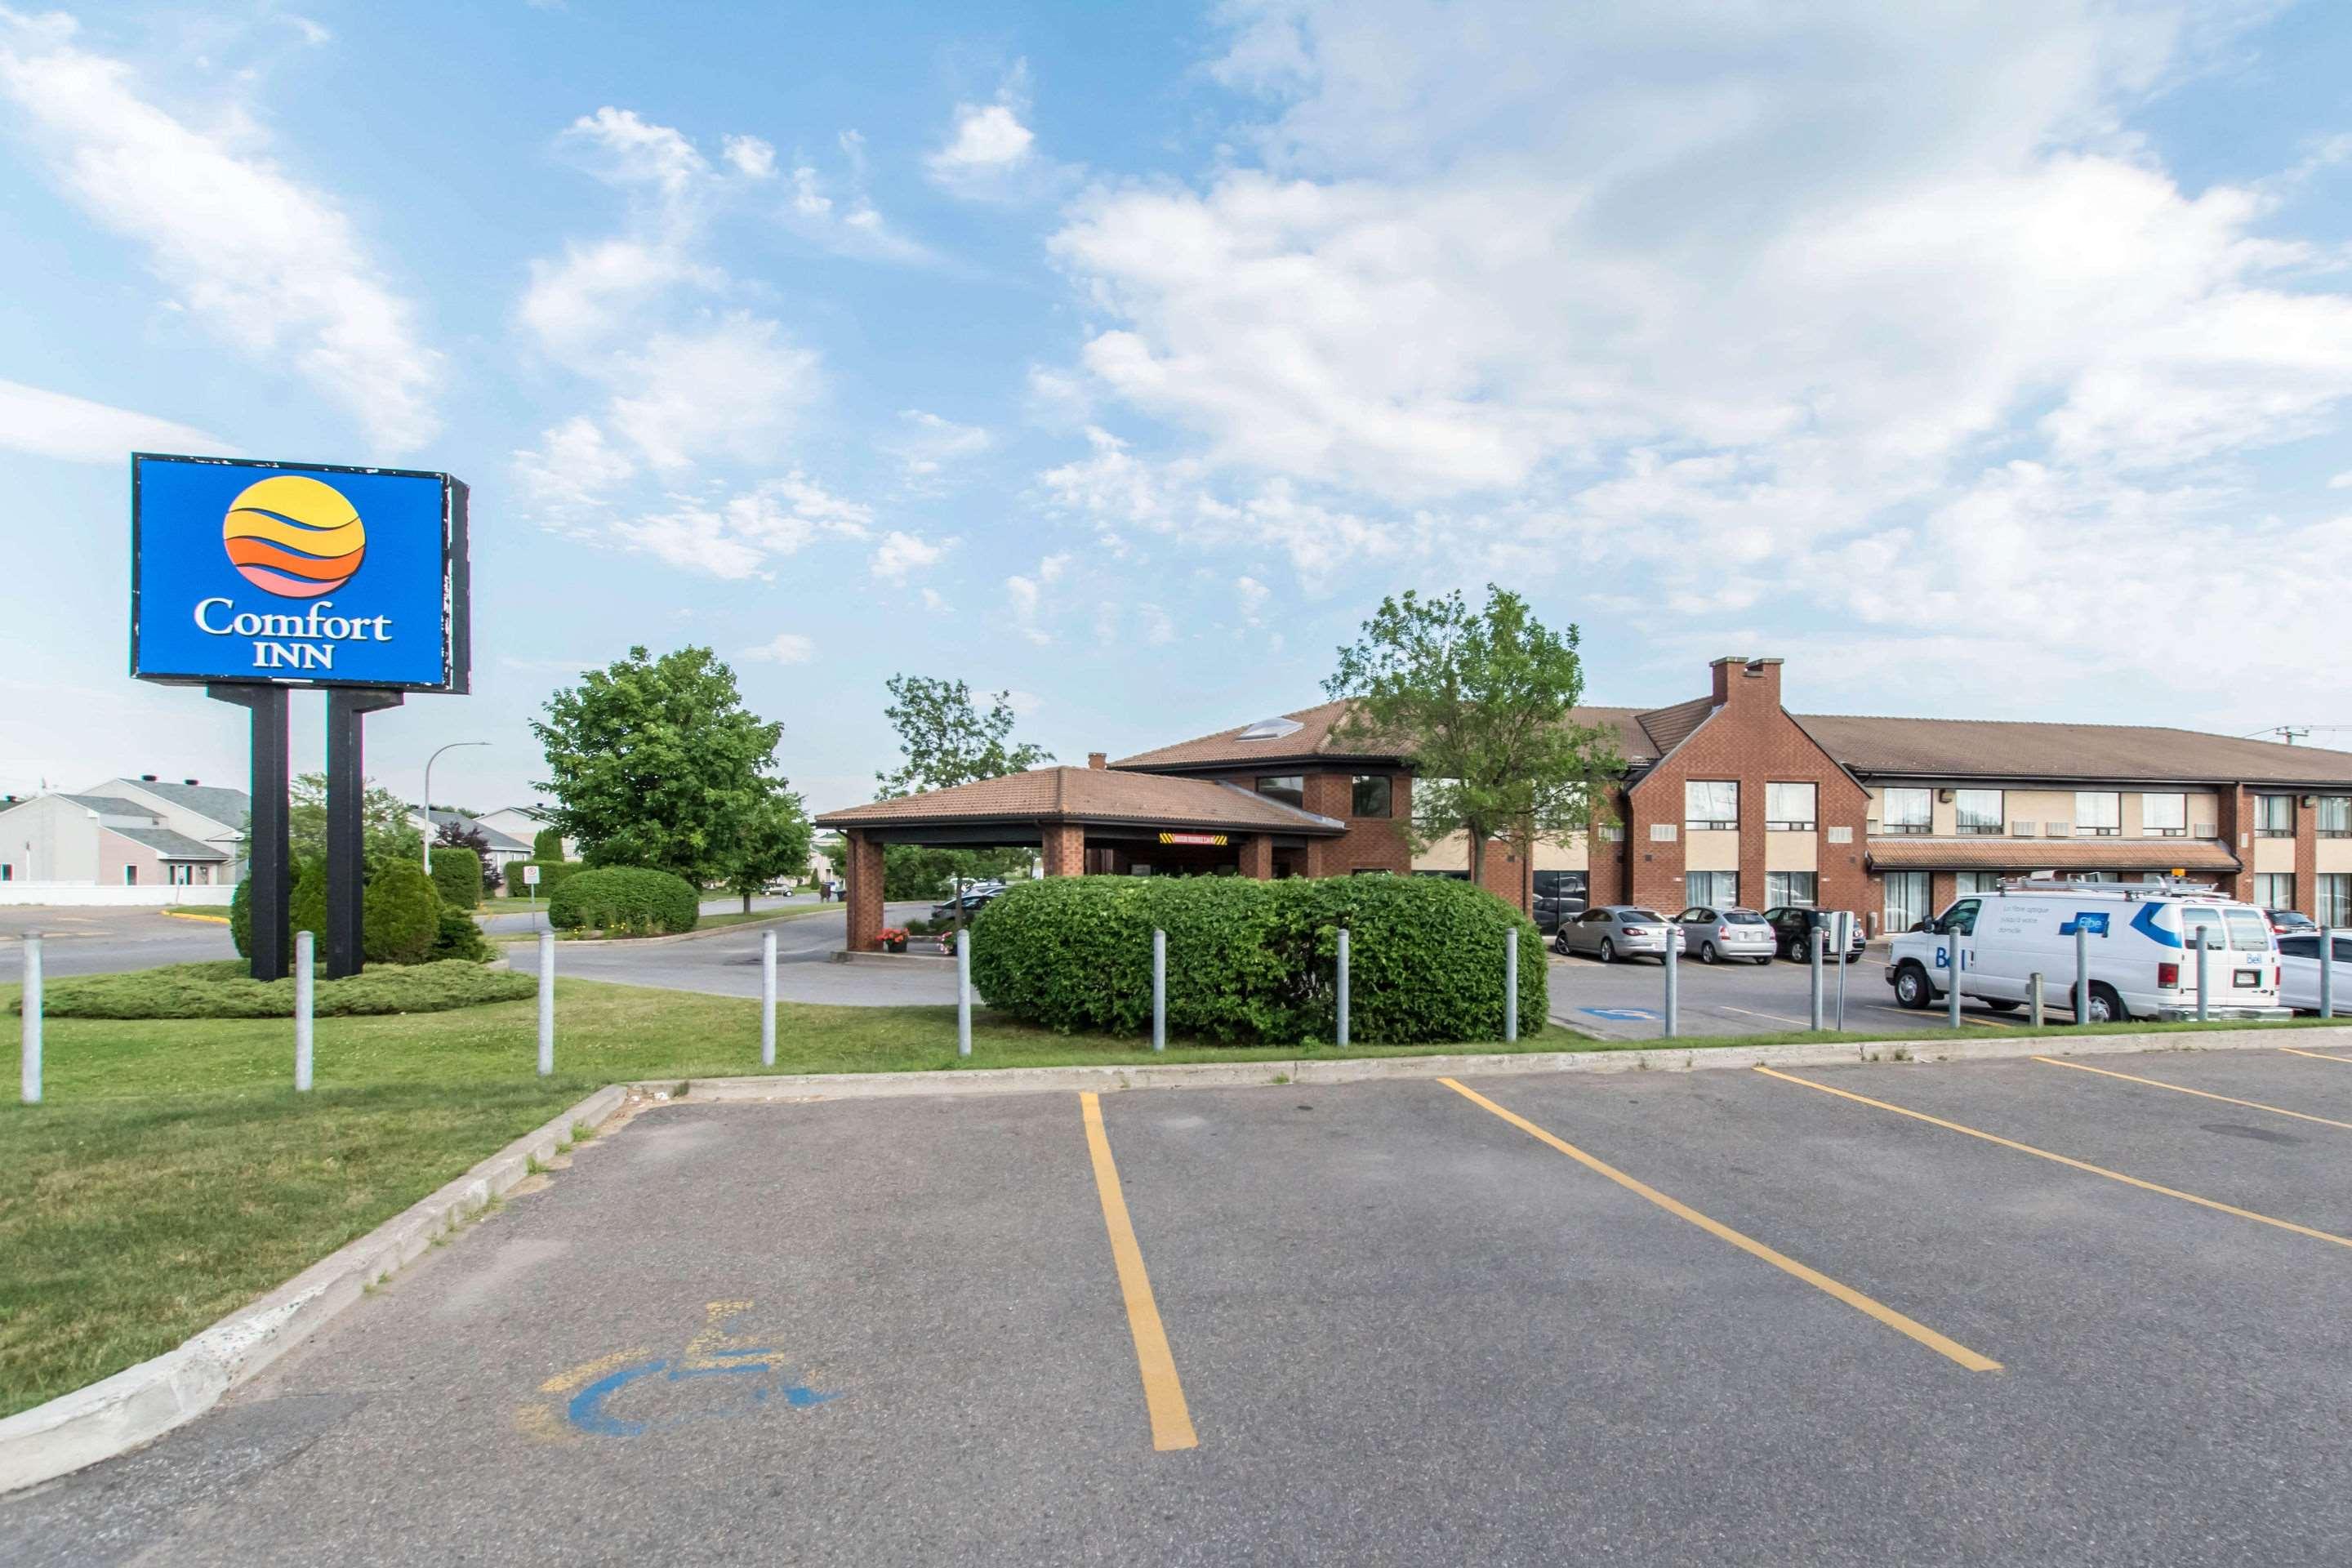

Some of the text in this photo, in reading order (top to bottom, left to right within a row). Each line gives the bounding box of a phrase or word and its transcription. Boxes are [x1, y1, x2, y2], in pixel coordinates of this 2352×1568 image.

[194, 597, 394, 642] Comfort
[252, 641, 336, 670] INN
[2247, 953, 2261, 964] Bell
